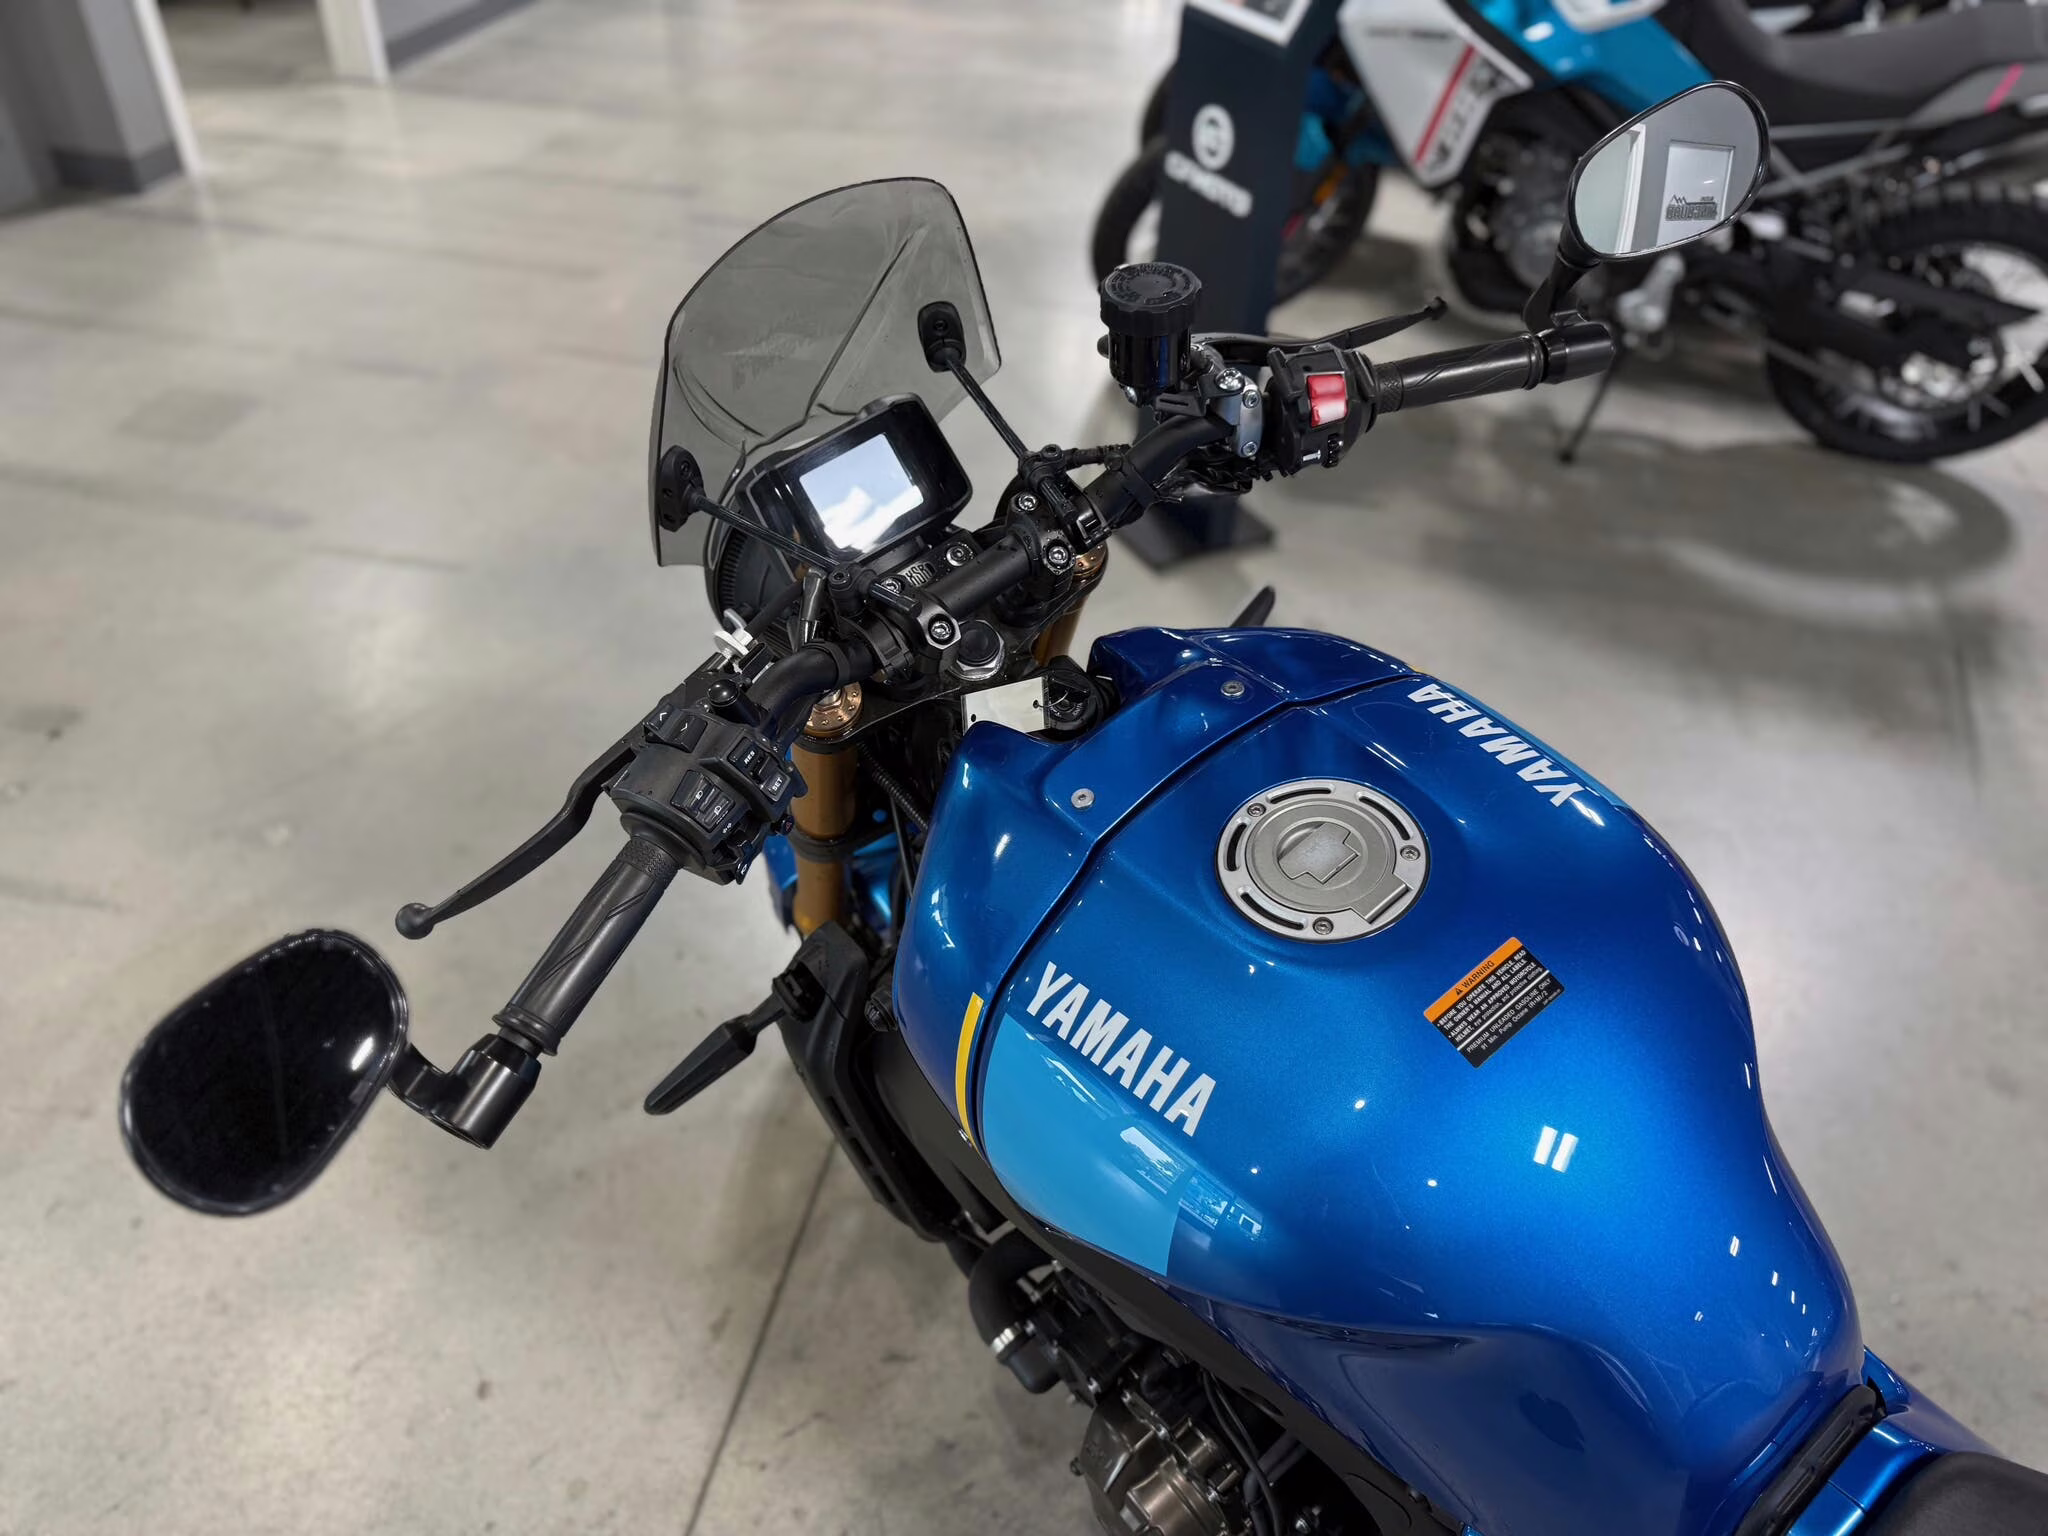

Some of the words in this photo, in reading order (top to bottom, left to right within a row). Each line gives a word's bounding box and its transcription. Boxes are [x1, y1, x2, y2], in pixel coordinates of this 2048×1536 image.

[905, 563, 933, 587] XSR
[743, 749, 756, 765] RES
[1407, 683, 1585, 808] YAMAHA
[772, 777, 783, 792] SET
[1438, 1008, 1457, 1025] BEFORE
[1456, 999, 1467, 1009] YOU
[1466, 983, 1486, 1001] OPERATE
[1485, 974, 1496, 984] THIS
[1513, 949, 1526, 960] READ
[1443, 1020, 1454, 1030] THE
[1453, 1003, 1474, 1021] OWNER'S
[1472, 989, 1492, 1004] MANUAL
[1491, 979, 1501, 989] AND
[1500, 973, 1510, 981] ALL
[1450, 1020, 1467, 1036] ALWAYS
[1466, 1009, 1480, 1021] WEAR
[1487, 984, 1509, 1004] APPROVED
[1509, 962, 1536, 985] MOTORCYCLE
[1461, 960, 1494, 988] WARNING
[1466, 1031, 1489, 1052] PREMIUM
[1489, 1009, 1515, 1032] UNLEADED
[1515, 988, 1539, 1010] GASOLINE
[1538, 978, 1550, 990] ONLY
[1498, 1021, 1512, 1034] Pump
[1026, 960, 1217, 1137] YAMAHA
